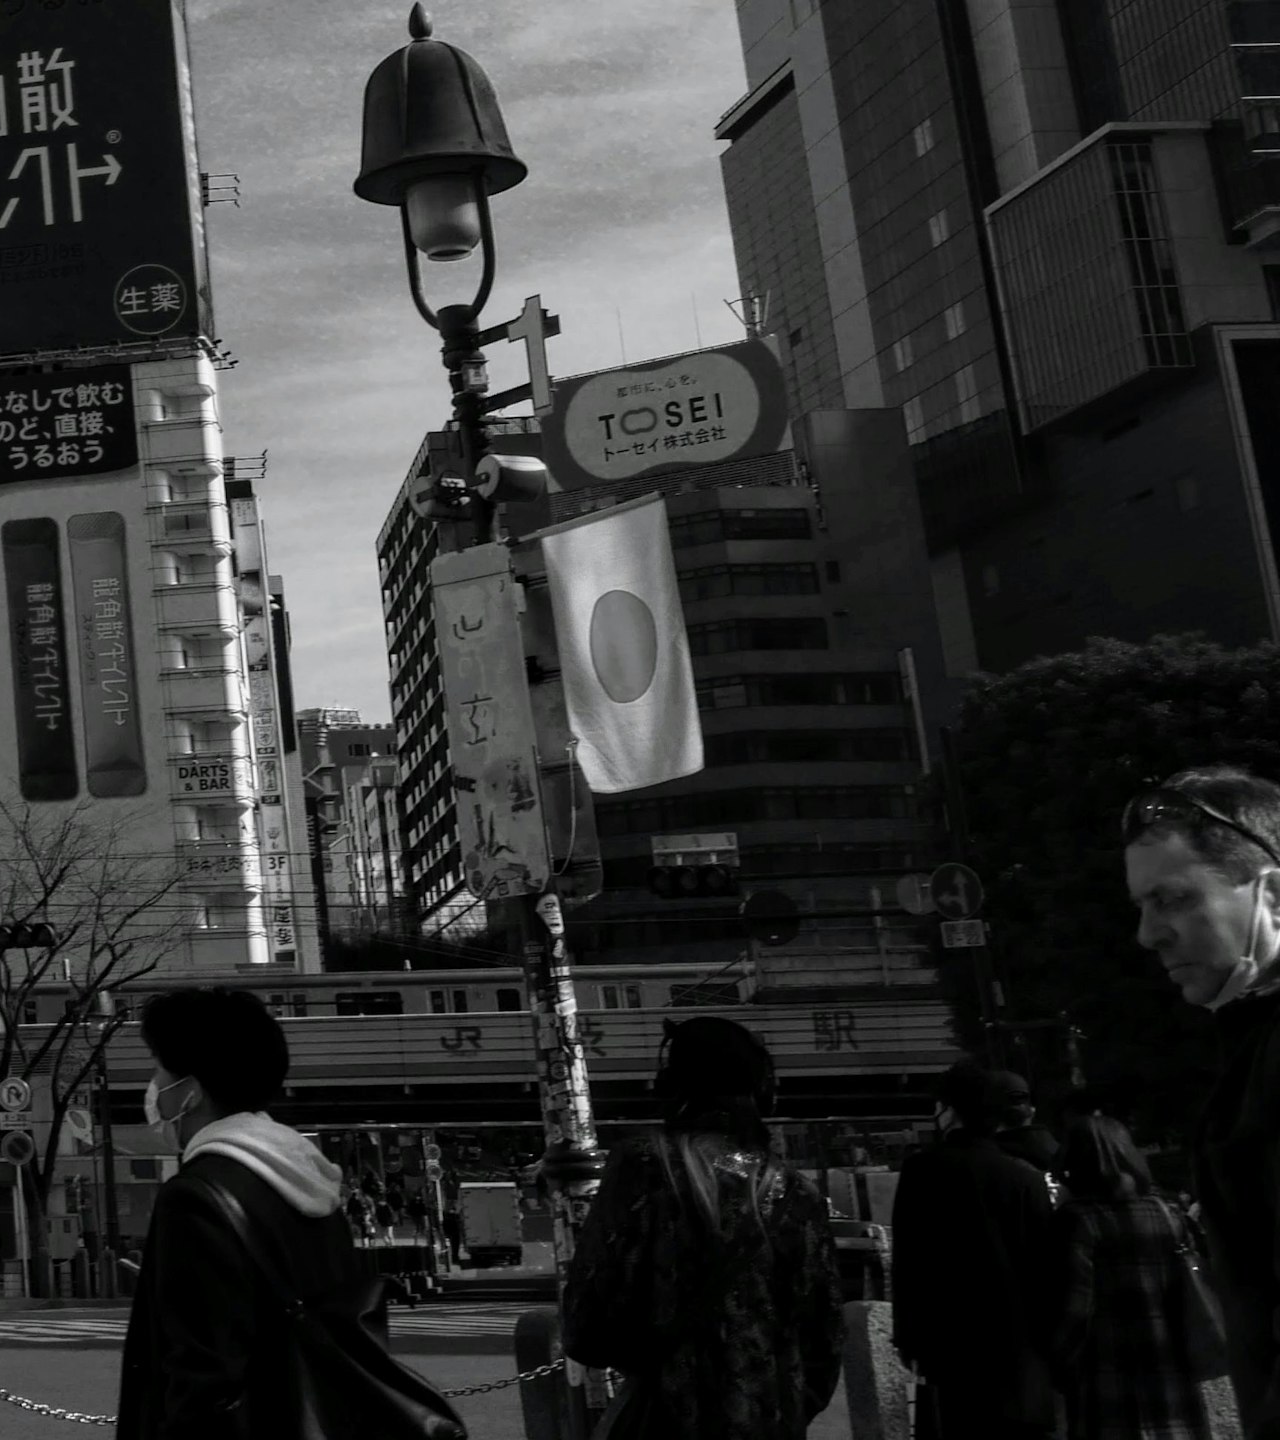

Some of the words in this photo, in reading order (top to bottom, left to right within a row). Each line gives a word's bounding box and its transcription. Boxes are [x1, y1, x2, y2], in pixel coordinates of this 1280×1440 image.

[119, 282, 181, 316] 生薬
[8, 439, 104, 471] うるおう
[603, 425, 728, 463] トーセイ株式会社
[178, 764, 229, 779] DARTS
[184, 782, 194, 791] &
[199, 777, 231, 791] BAR
[268, 856, 286, 870] 3F
[441, 1026, 482, 1050] JR
[812, 1010, 859, 1051] 駅
